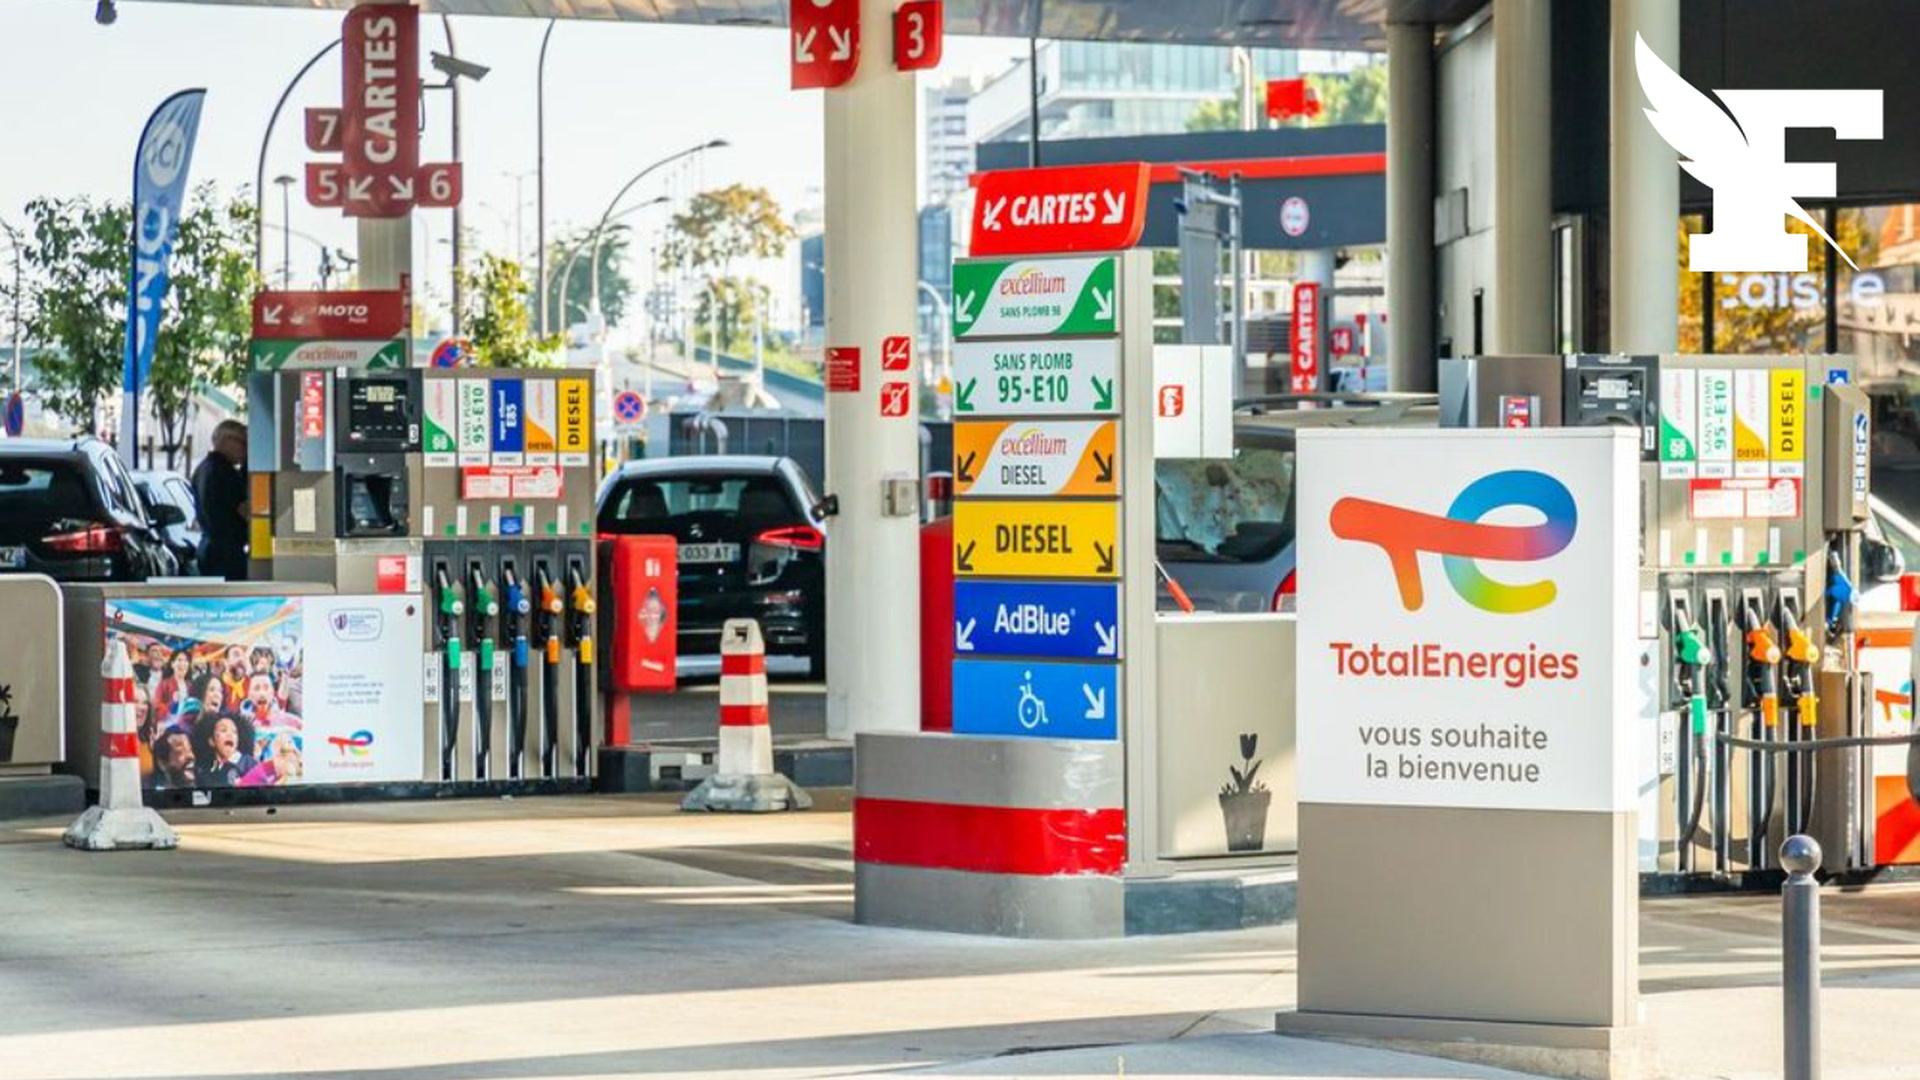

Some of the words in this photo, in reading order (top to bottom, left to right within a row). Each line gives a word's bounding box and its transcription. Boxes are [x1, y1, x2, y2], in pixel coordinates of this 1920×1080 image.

[907, 12, 925, 58] 3
[365, 16, 397, 164] CARTES
[318, 115, 338, 146] 7
[318, 169, 339, 200] 5
[430, 169, 450, 200] 6
[1010, 191, 1097, 227] CARTES
[1000, 270, 1065, 296] excellium
[318, 305, 368, 316] MOTO
[1000, 306, 1021, 318] SANS
[1023, 305, 1050, 317] PLOMB
[1299, 287, 1313, 370] CARTES
[994, 353, 1026, 371] SANS
[1030, 352, 1074, 370] PLOMB
[998, 374, 1069, 402] 95-E10
[473, 386, 485, 443] 95-E10
[568, 386, 580, 446] DIESEL
[1714, 380, 1727, 450] 95-E10
[1782, 377, 1794, 452] DIESEL
[1001, 432, 1067, 456] excellium
[1001, 465, 1046, 485] DIESEL
[996, 524, 1072, 553] DIESEL
[1329, 642, 1578, 688] TotalEnergies
[1358, 726, 1421, 747] vous
[1430, 723, 1548, 750] souhaite
[1366, 754, 1388, 778] la
[1398, 755, 1540, 783] bienvenue
